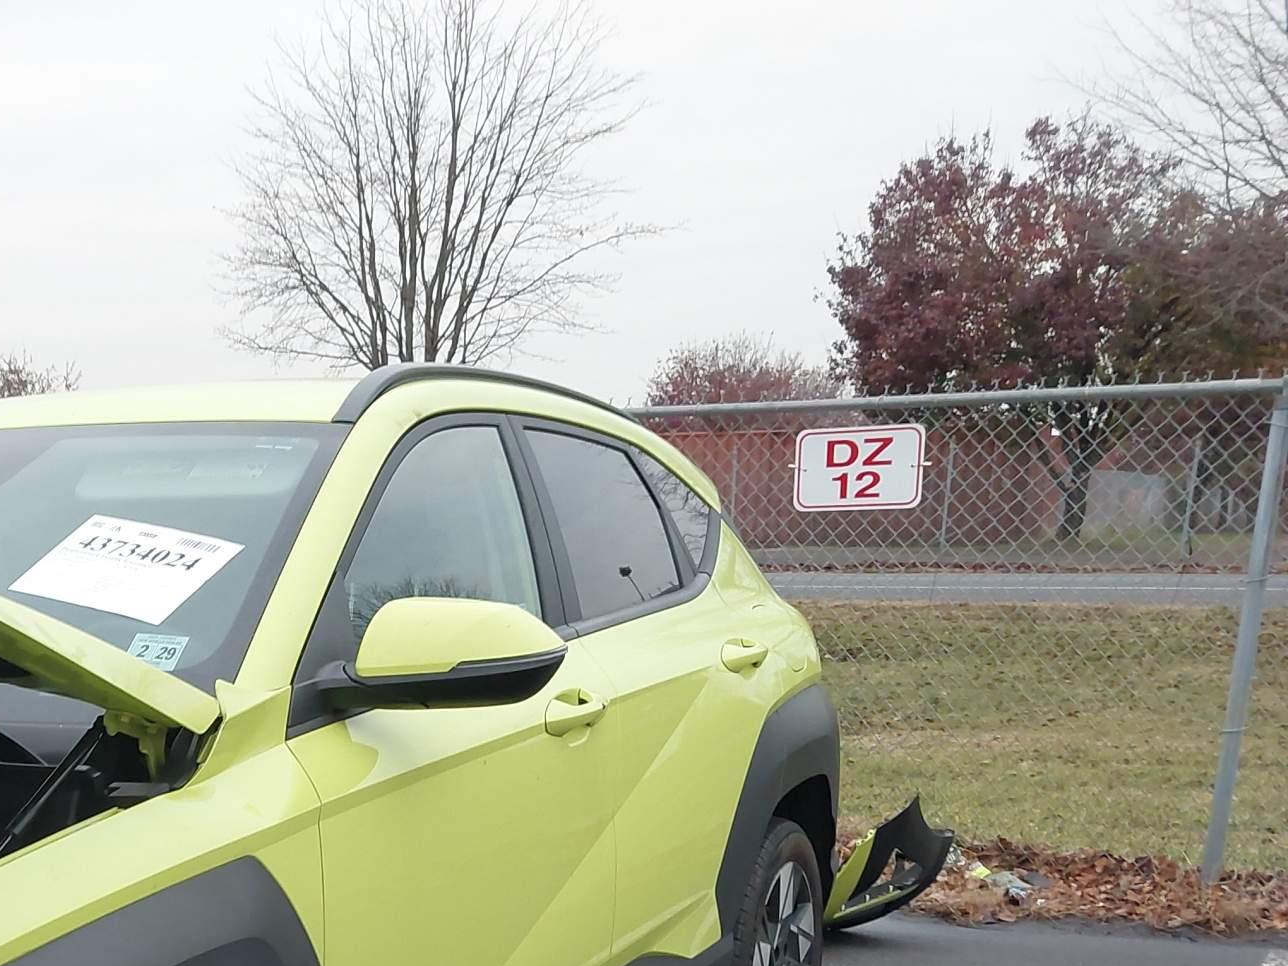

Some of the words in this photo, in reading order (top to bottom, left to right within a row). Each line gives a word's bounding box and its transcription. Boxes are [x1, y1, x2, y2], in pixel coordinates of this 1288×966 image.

[825, 436, 894, 468] DZ
[831, 470, 881, 499] 12
[78, 535, 202, 571] 43734024
[136, 644, 150, 658] 2
[154, 646, 177, 661] 29
